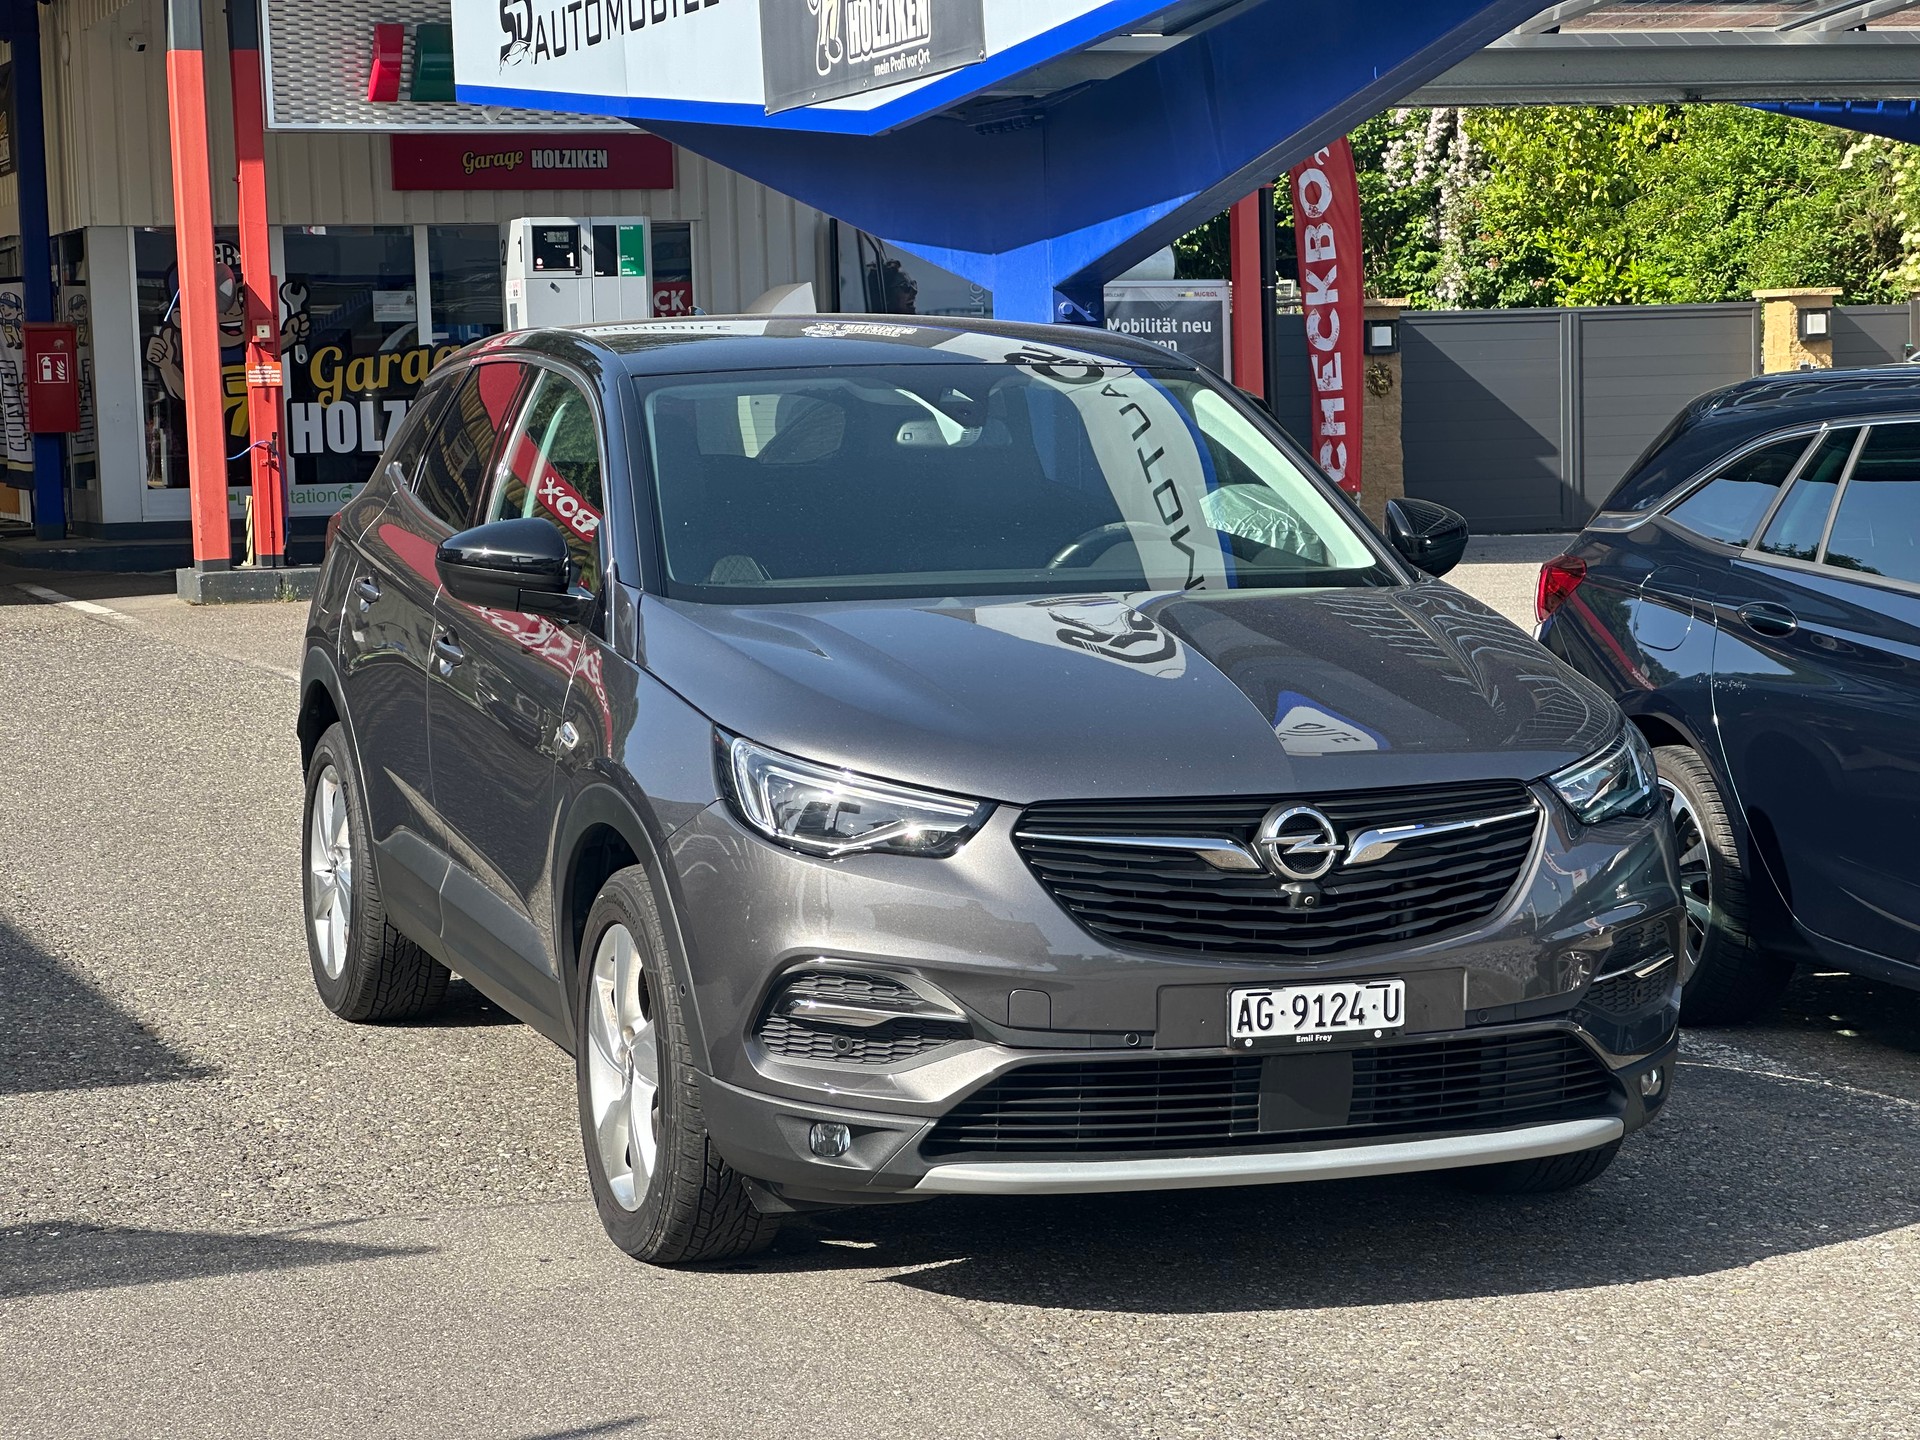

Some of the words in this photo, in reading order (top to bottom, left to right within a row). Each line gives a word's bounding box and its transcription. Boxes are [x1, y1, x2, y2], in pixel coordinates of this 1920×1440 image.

[534, 0, 719, 65] AUTOMO
[874, 61, 890, 77] mein
[890, 54, 906, 73] Profi
[917, 48, 931, 66] Ort
[462, 149, 524, 175] Garage
[531, 149, 608, 169] HOLZIKEN
[566, 251, 575, 267] 1
[1106, 317, 1178, 334] Mobilität
[1182, 320, 1212, 333] neu
[291, 400, 414, 453] HOLZ
[1296, 1034, 1313, 1043] Emil
[1315, 1033, 1333, 1044] Frey
